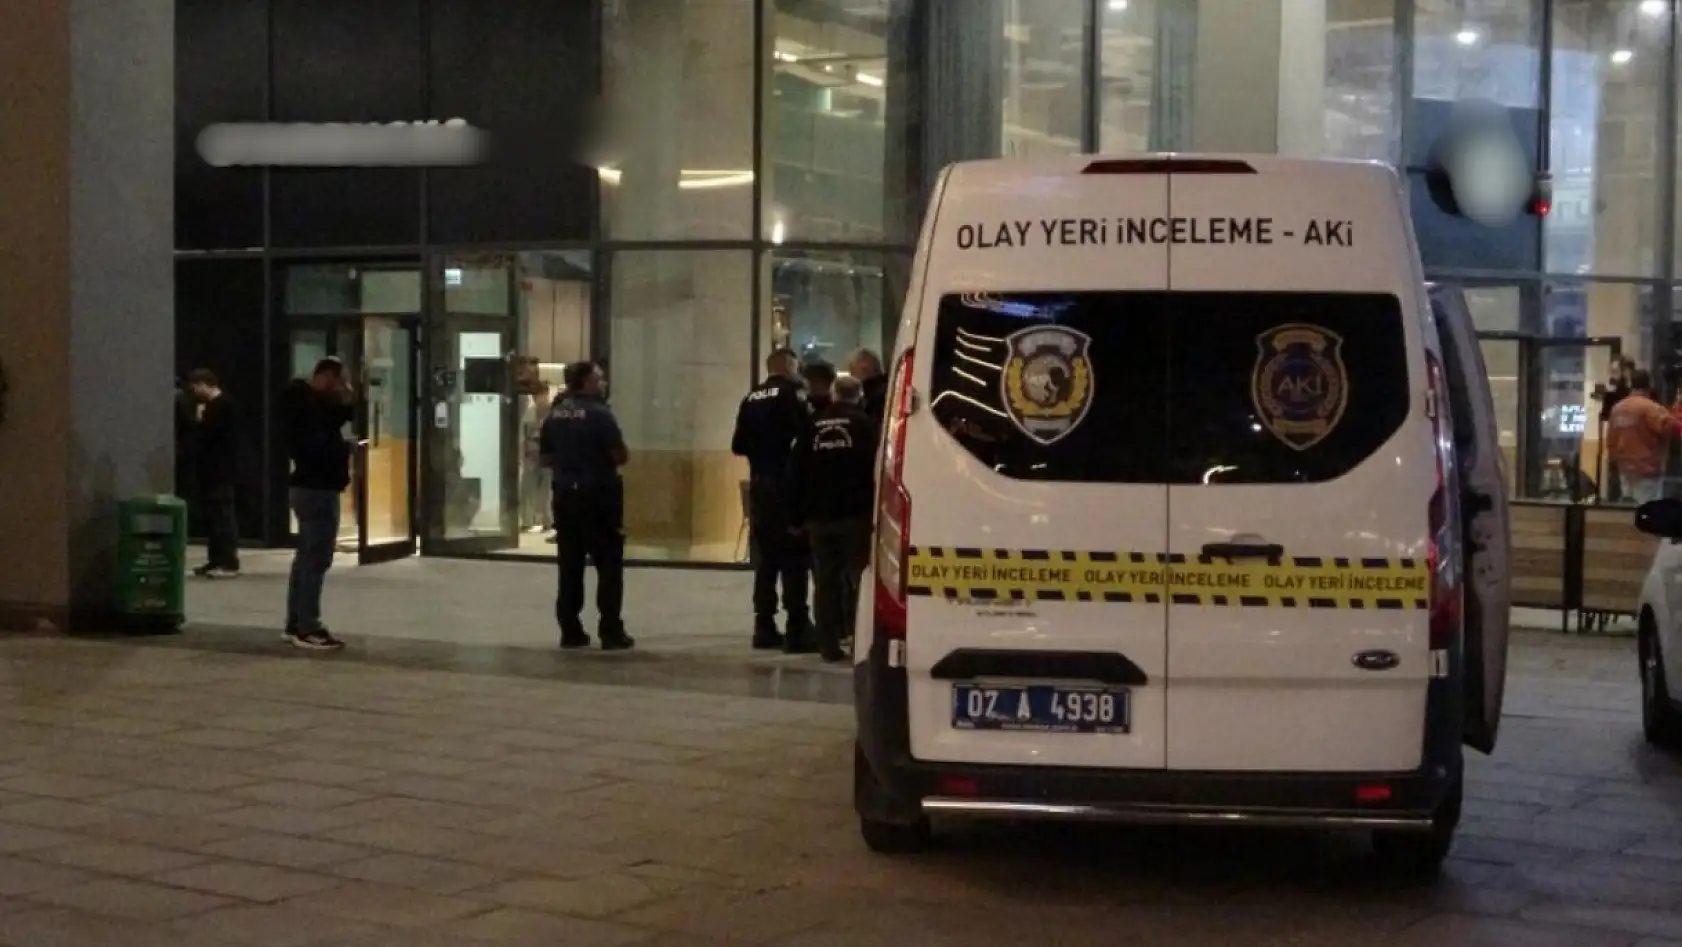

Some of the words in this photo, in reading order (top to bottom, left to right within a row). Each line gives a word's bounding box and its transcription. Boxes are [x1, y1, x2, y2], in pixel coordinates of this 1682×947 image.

[956, 220, 1032, 250] OLAY
[911, 564, 948, 580] OLAY
[1084, 569, 1126, 585] OLAY
[1264, 573, 1304, 589] OLAY
[1017, 690, 1031, 721] A
[1051, 692, 1115, 723] 4938
